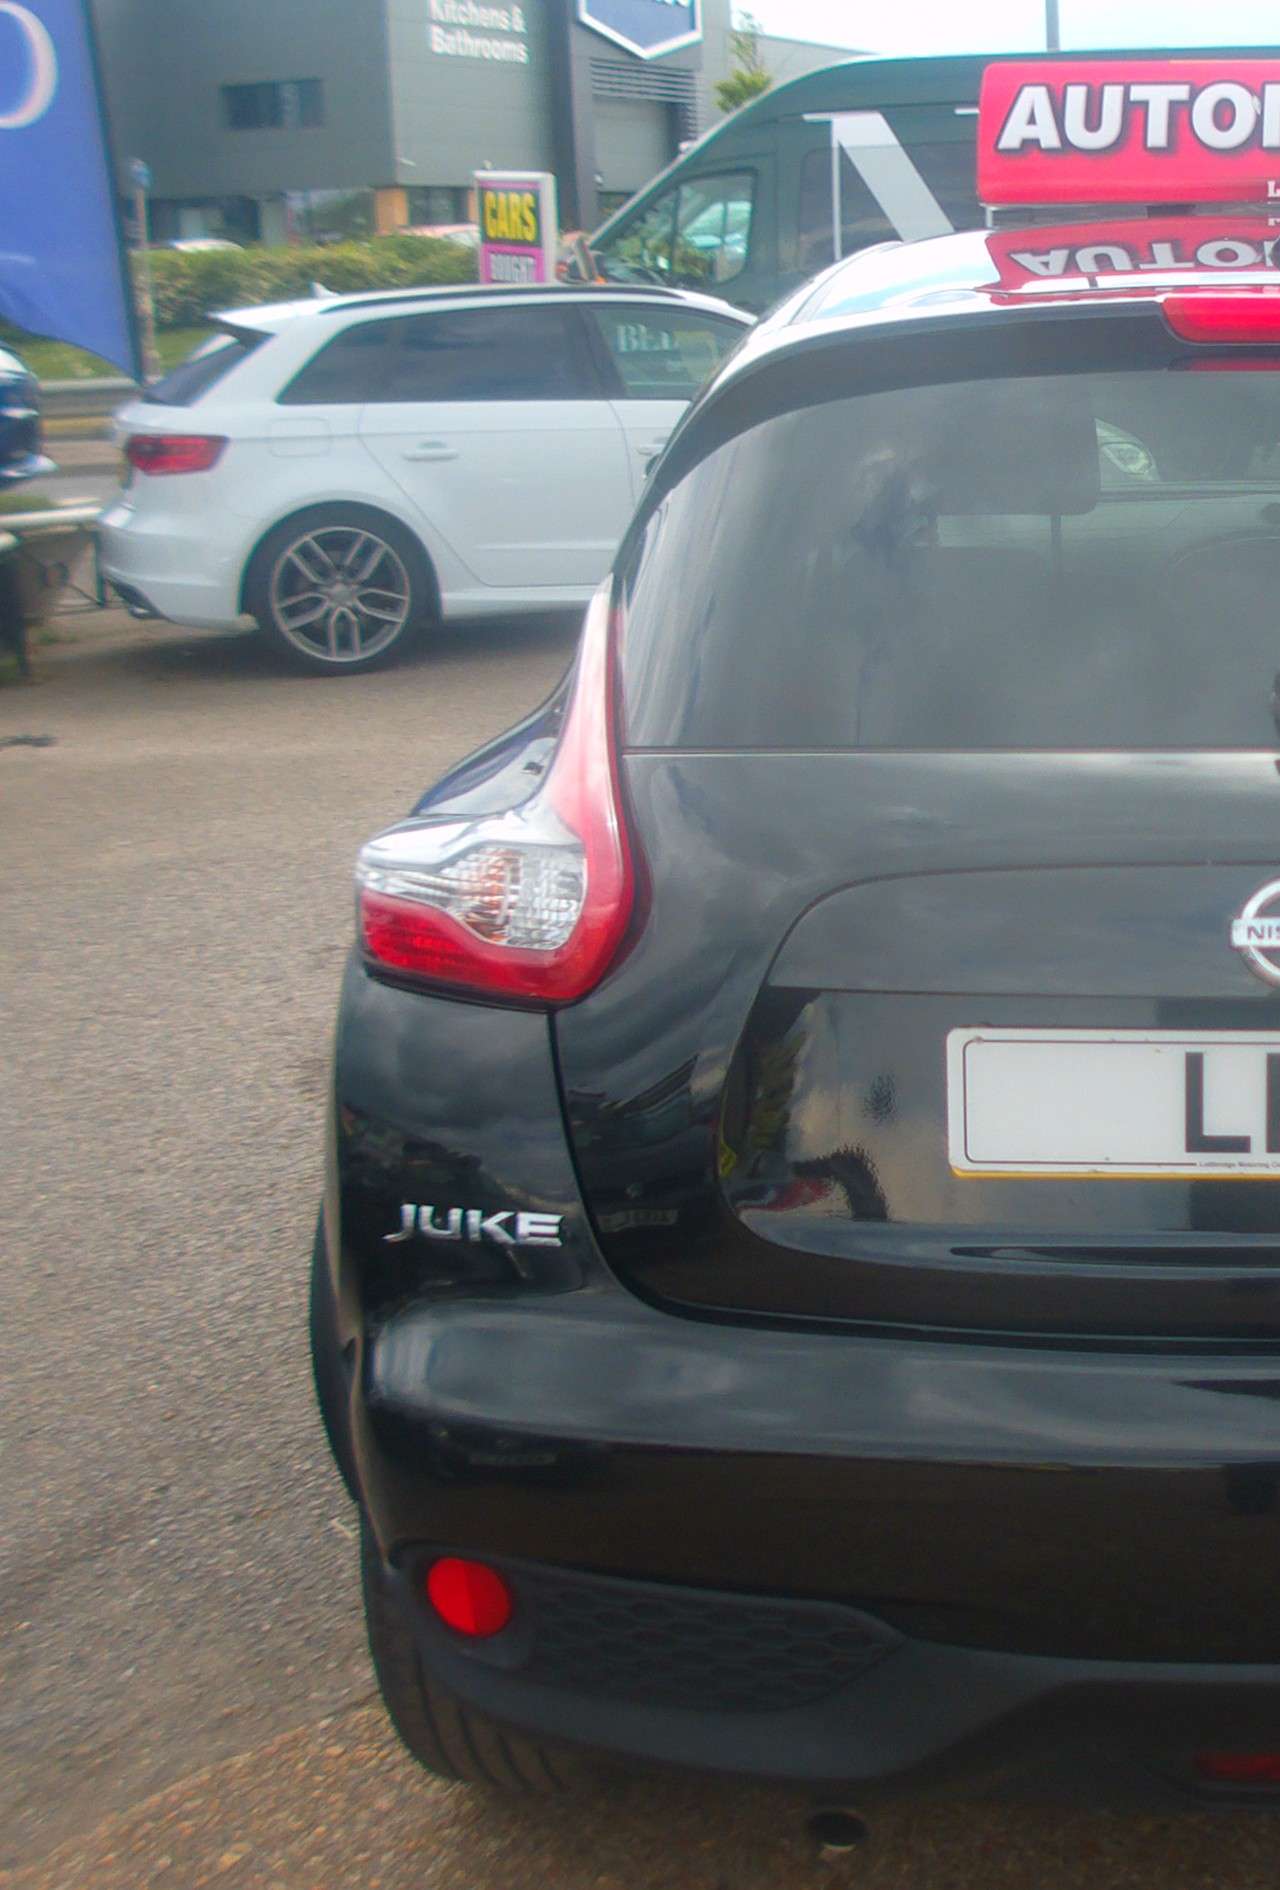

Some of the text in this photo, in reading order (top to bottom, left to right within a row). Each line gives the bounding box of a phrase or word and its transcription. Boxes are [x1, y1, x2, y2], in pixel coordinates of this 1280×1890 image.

[430, 0, 528, 33] Kitchens &
[431, 24, 528, 64] Bathrooms
[484, 190, 537, 242] CARS
[382, 1203, 565, 1248] JUKE
